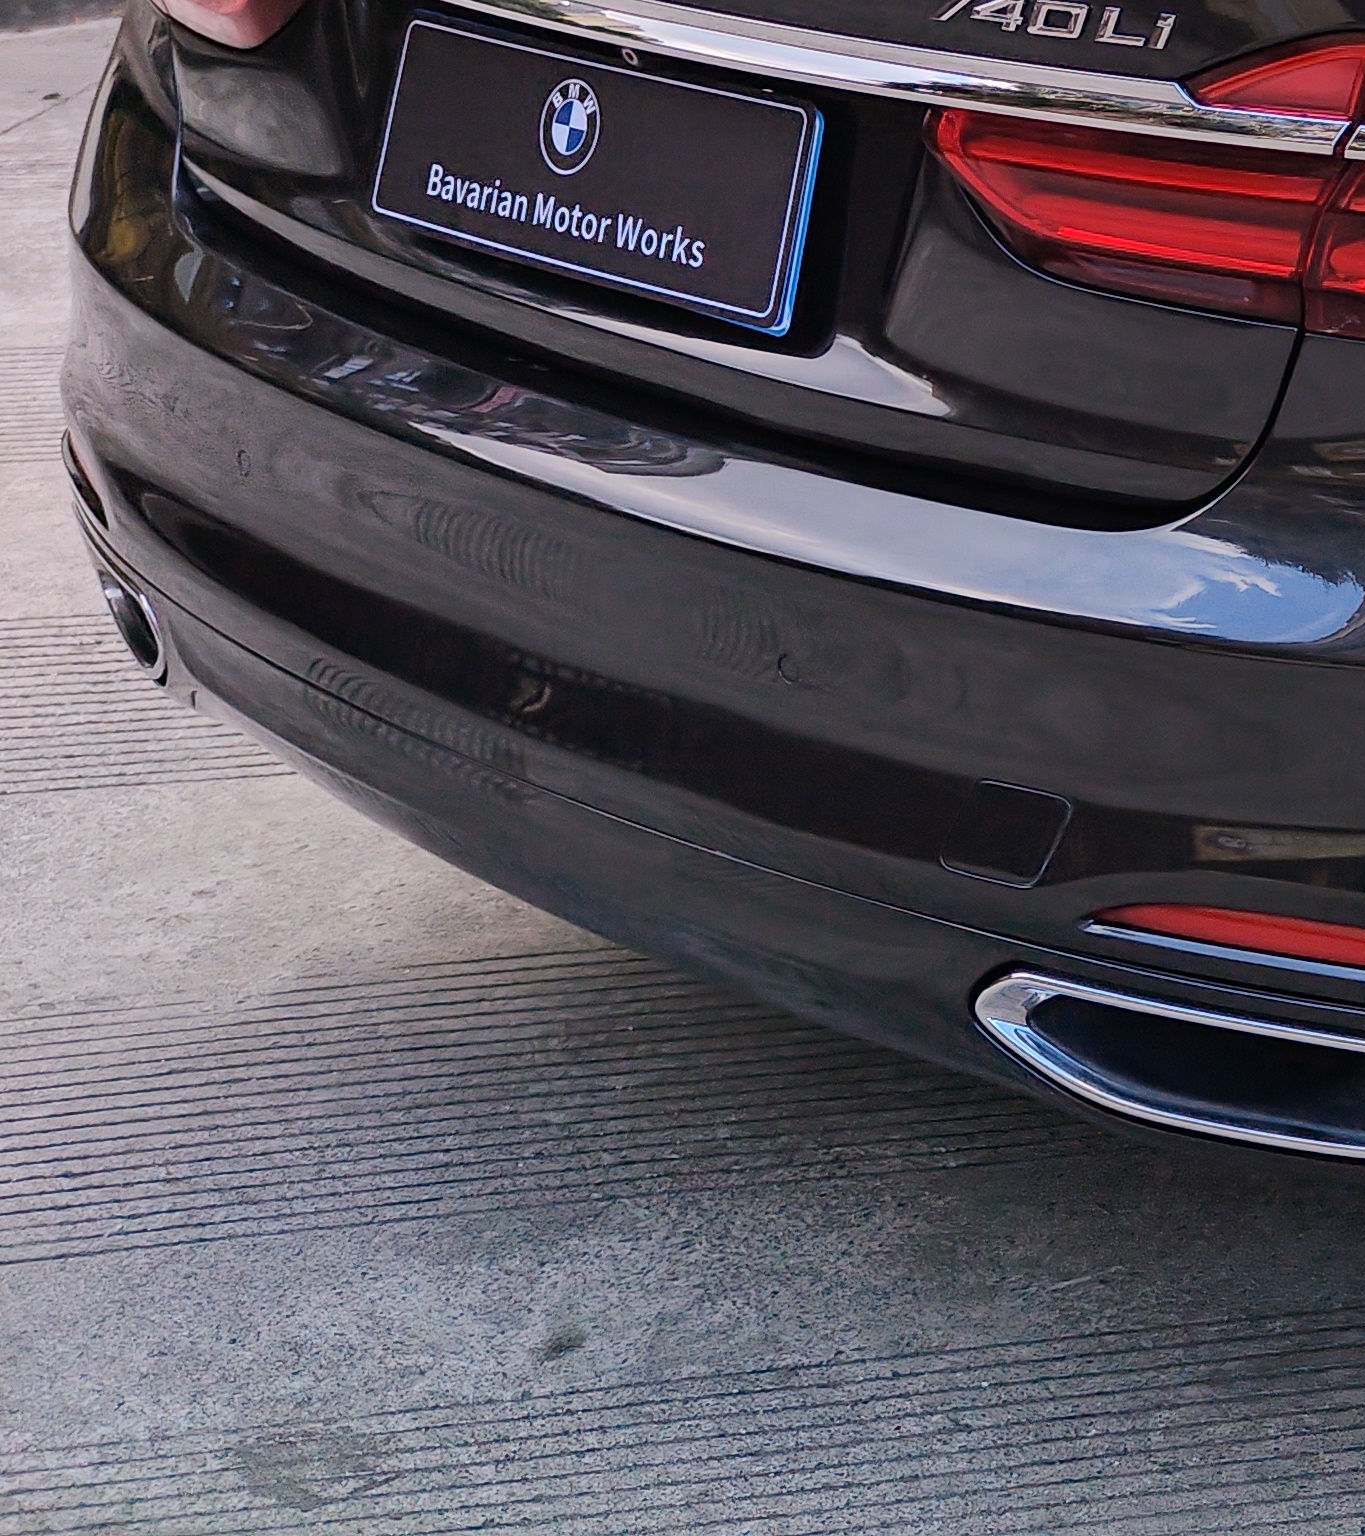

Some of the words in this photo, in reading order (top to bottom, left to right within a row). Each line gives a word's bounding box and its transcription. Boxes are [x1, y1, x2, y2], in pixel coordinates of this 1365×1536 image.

[552, 83, 596, 115] BMW
[426, 163, 528, 222] Bavarian
[532, 192, 612, 243] Motor
[616, 214, 706, 269] Works
